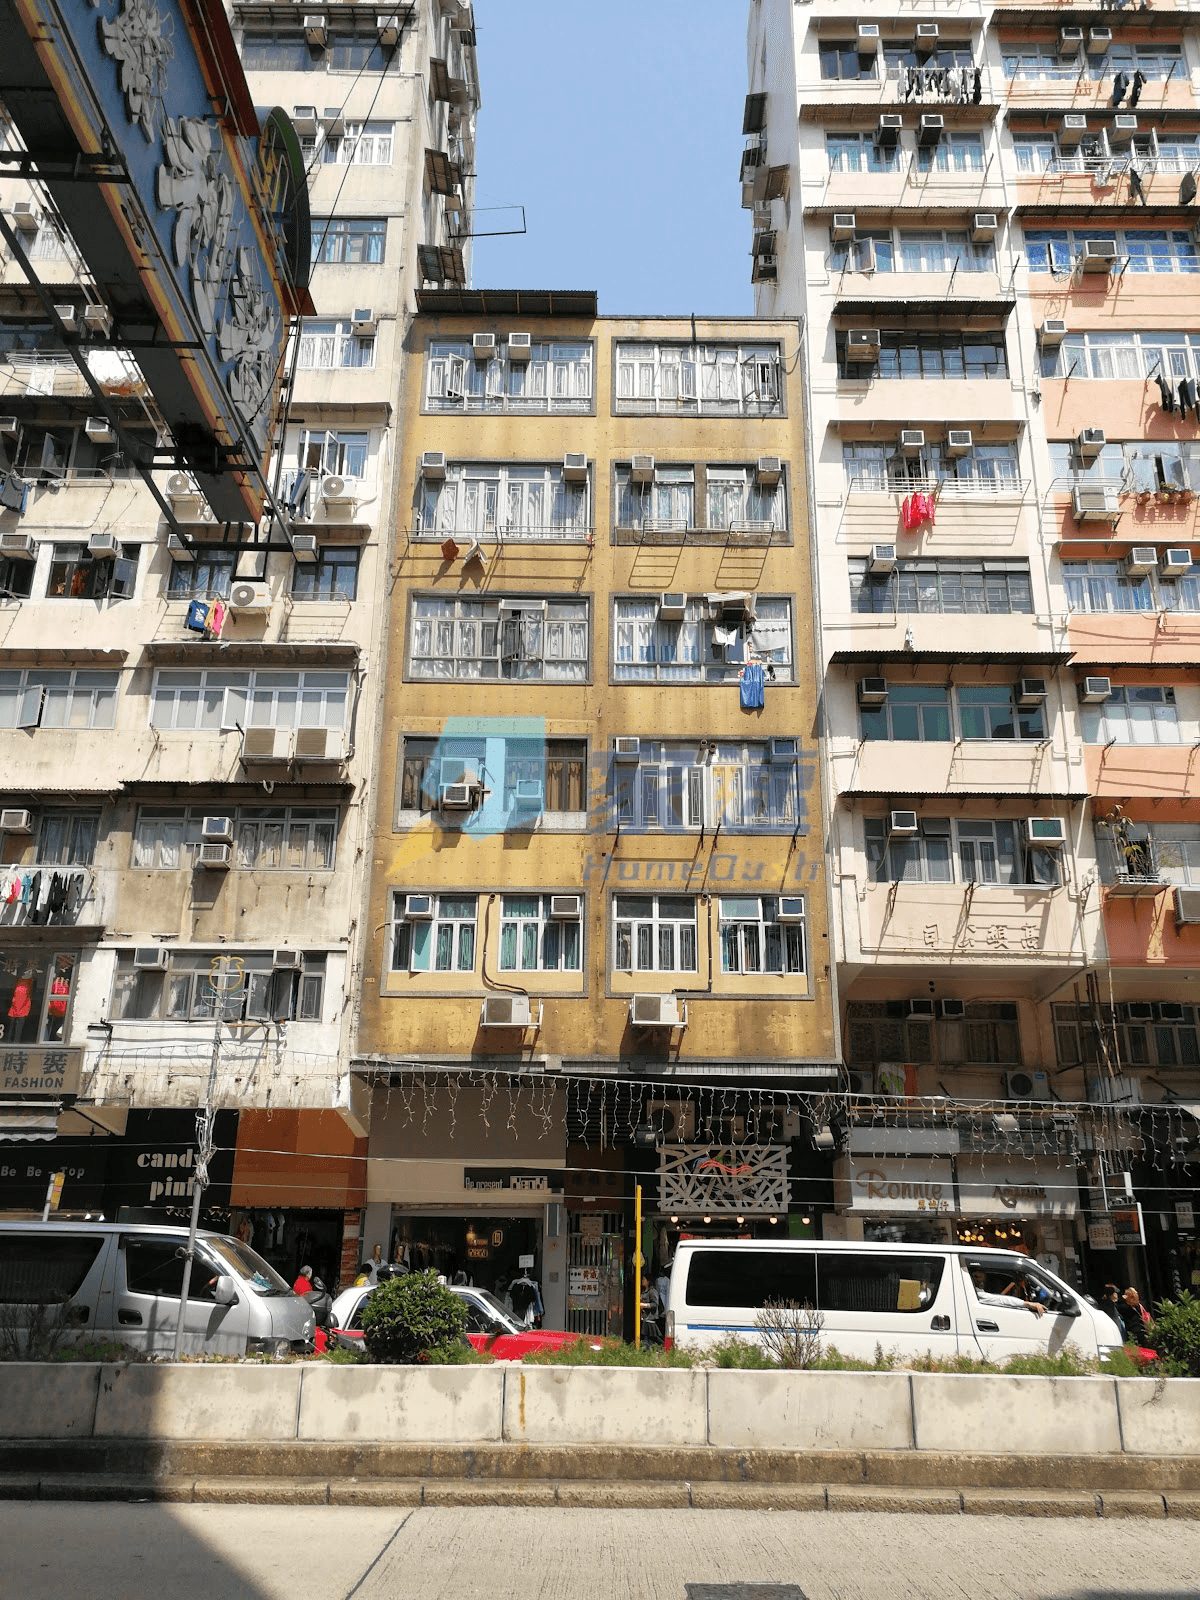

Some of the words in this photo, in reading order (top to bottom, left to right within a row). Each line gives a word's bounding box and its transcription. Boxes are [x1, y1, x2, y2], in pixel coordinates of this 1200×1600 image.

[4, 1077, 64, 1088] FASHION
[1, 1165, 17, 1178] Be
[26, 1165, 42, 1178] Be
[60, 1166, 85, 1179] Top
[856, 1168, 943, 1200] Ronnie
